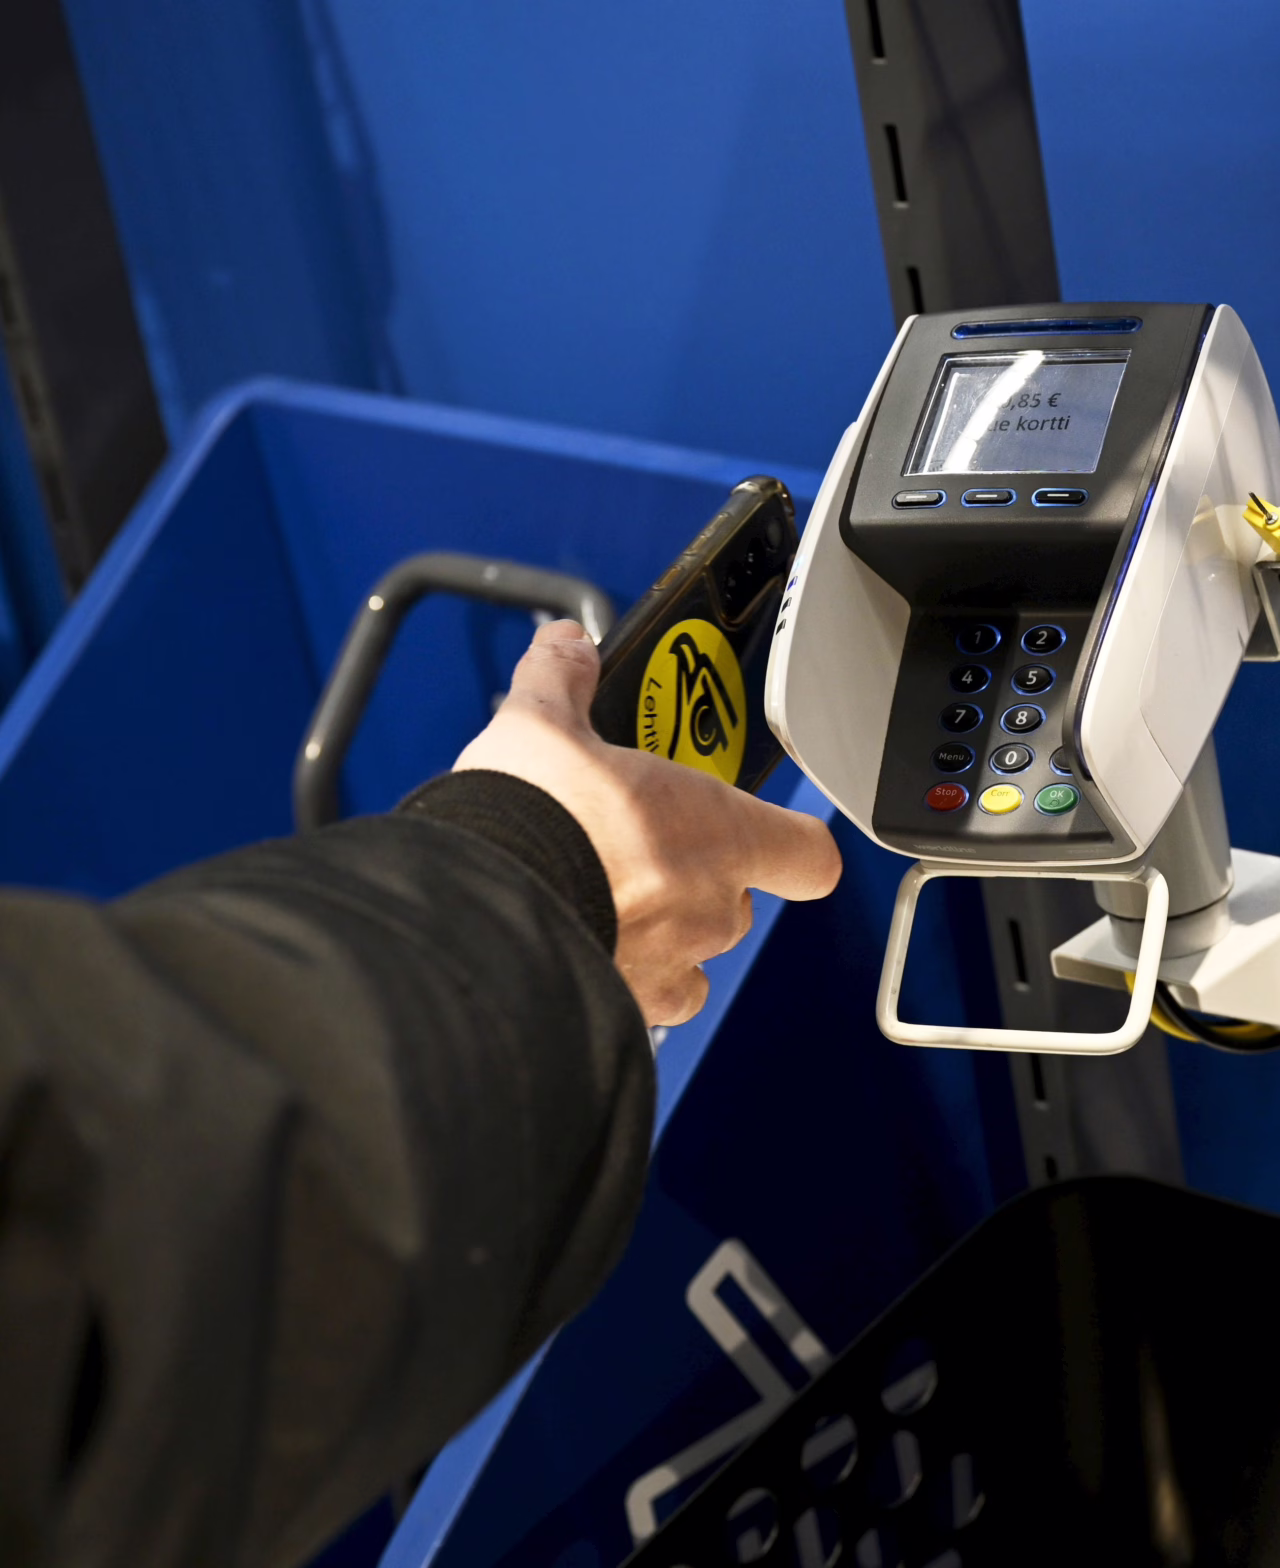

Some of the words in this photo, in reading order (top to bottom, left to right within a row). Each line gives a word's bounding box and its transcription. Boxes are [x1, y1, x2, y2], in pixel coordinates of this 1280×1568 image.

[1048, 392, 1061, 408] €
[1016, 415, 1071, 431] kortti
[1035, 630, 1047, 645] 2
[961, 670, 973, 684] 4
[1026, 670, 1038, 685] 5
[954, 709, 966, 724] 7
[1015, 711, 1028, 725] 8
[938, 752, 965, 762] Menu
[1005, 751, 1017, 765] 0
[934, 787, 957, 797] Stop
[990, 789, 1010, 797] Corr
[1049, 790, 1065, 798] OK
